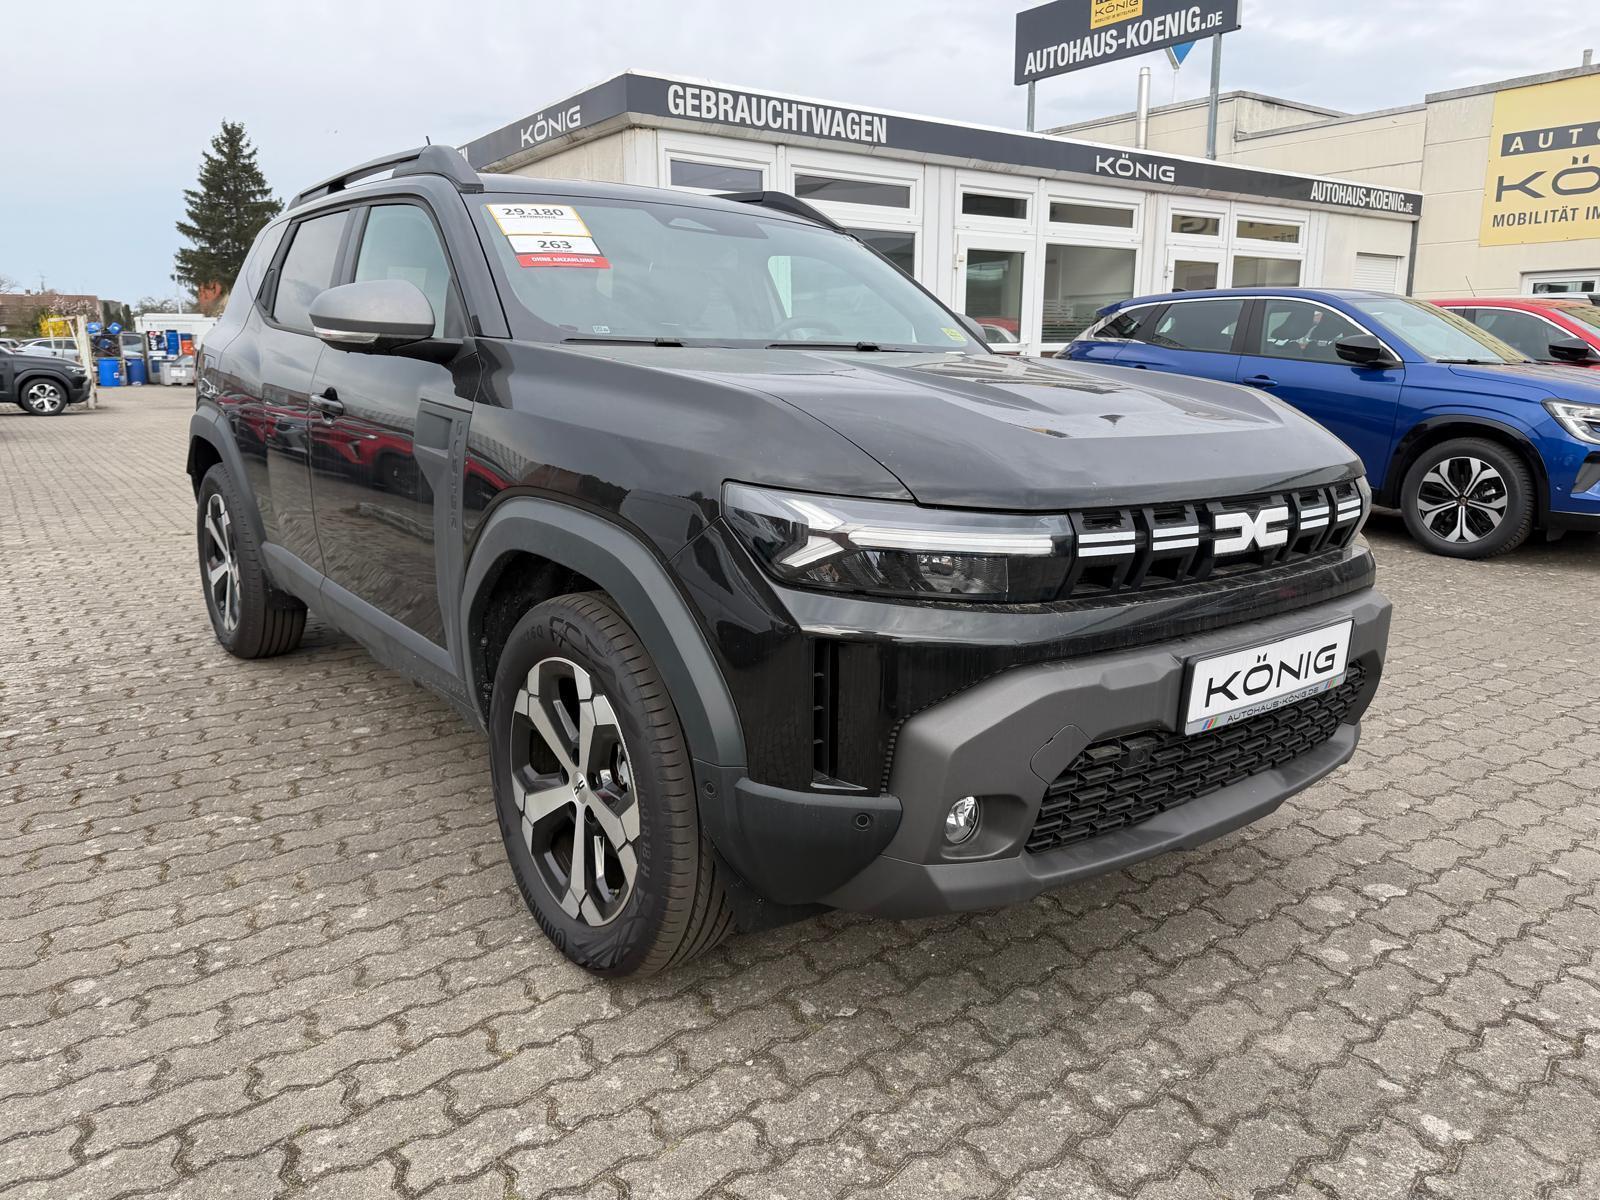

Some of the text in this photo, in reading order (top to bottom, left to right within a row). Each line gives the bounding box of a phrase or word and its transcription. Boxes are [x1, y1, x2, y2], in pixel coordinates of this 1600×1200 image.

[1094, 0, 1139, 16] KÖNIG
[1024, 6, 1223, 76] AUTOHAUS-KOENIG.DE
[520, 104, 581, 148] KÖNIG
[667, 84, 887, 144] GEBRAUCHTWAGEN
[1509, 126, 1600, 153] AUT
[1095, 153, 1175, 182] KÖNIG
[1495, 154, 1600, 203] KÖ
[502, 208, 564, 216] 29.180
[1310, 181, 1414, 213] AUTOHAUS-KOENIG.DE
[1492, 206, 1579, 228] MOBILITÄT
[537, 240, 572, 249] 263
[1204, 643, 1338, 708] KÖNIG
[1227, 686, 1319, 723] AUTOHAUS-KÖNIG.DE
